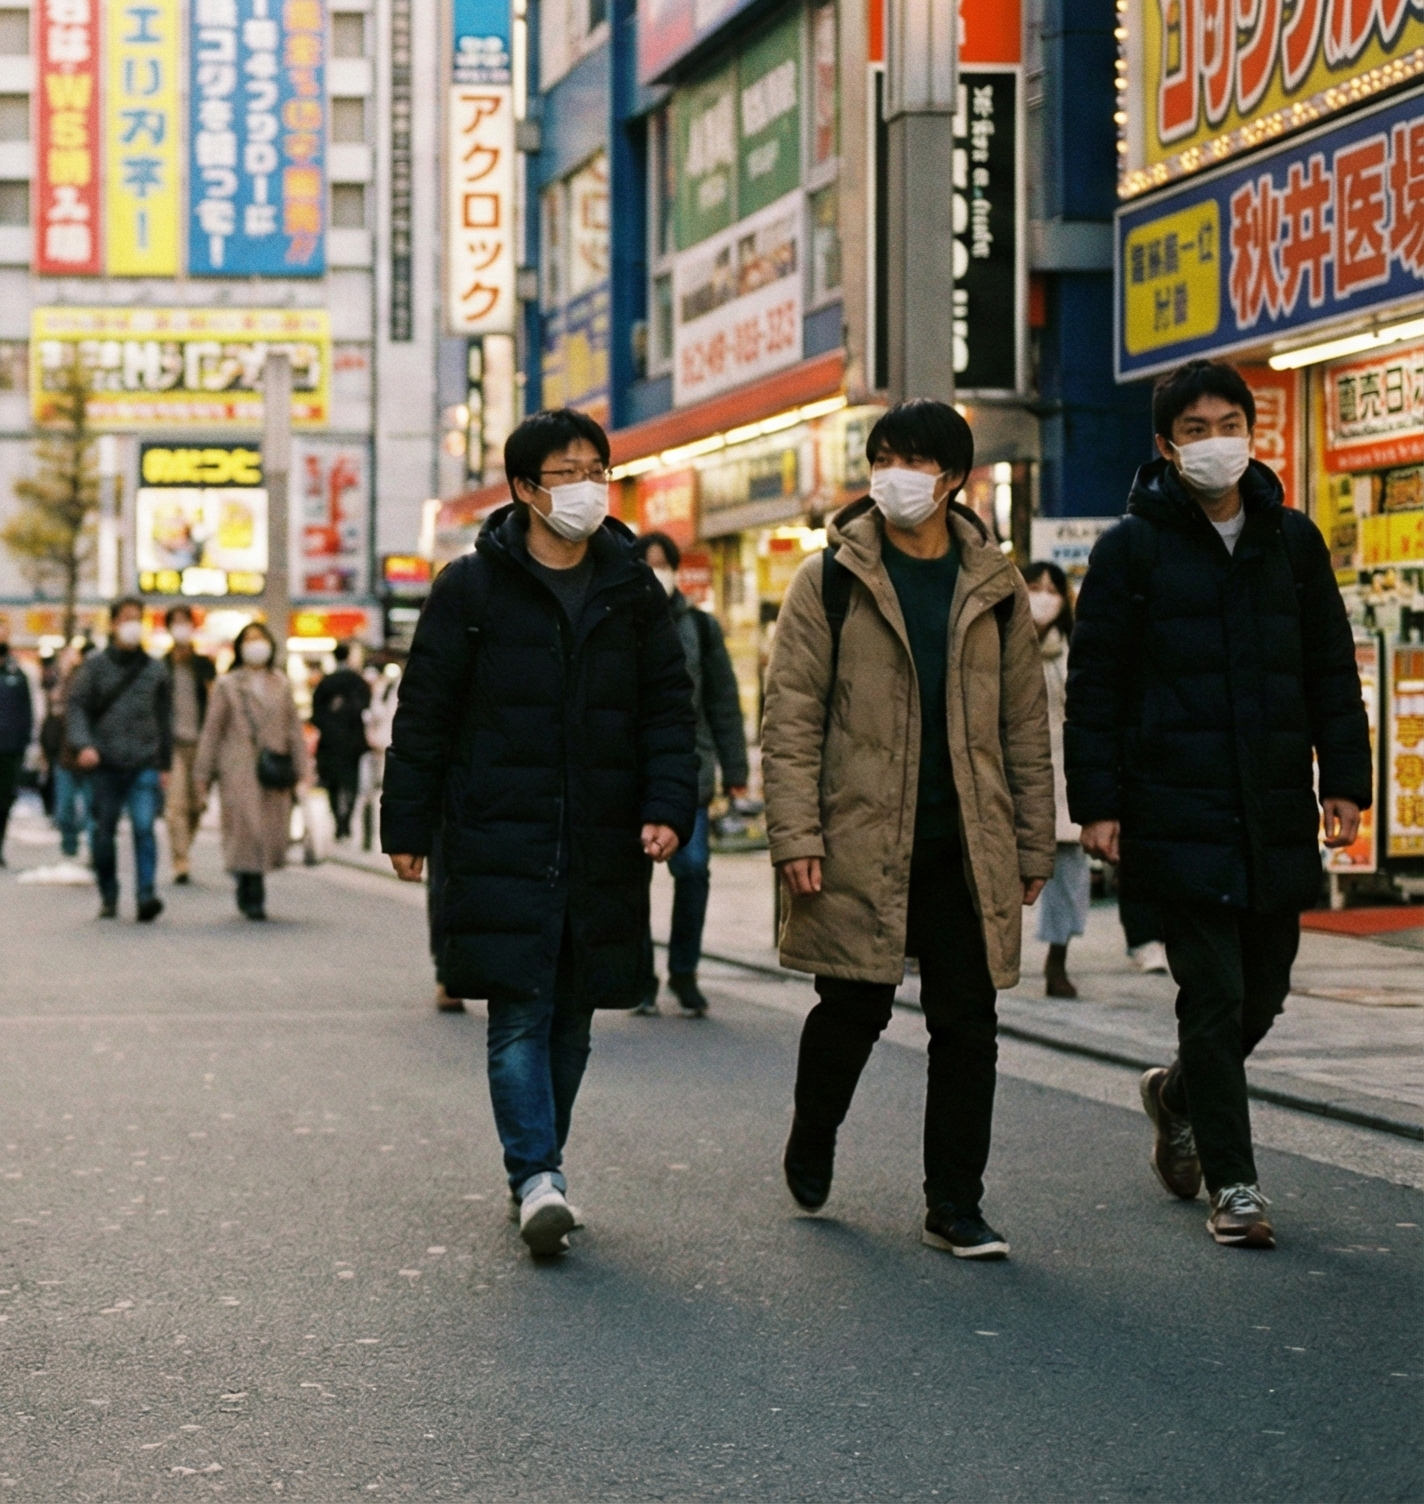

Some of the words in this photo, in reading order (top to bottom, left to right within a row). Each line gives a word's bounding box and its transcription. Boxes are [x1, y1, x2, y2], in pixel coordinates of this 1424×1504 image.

[461, 94, 503, 322] アクロック
